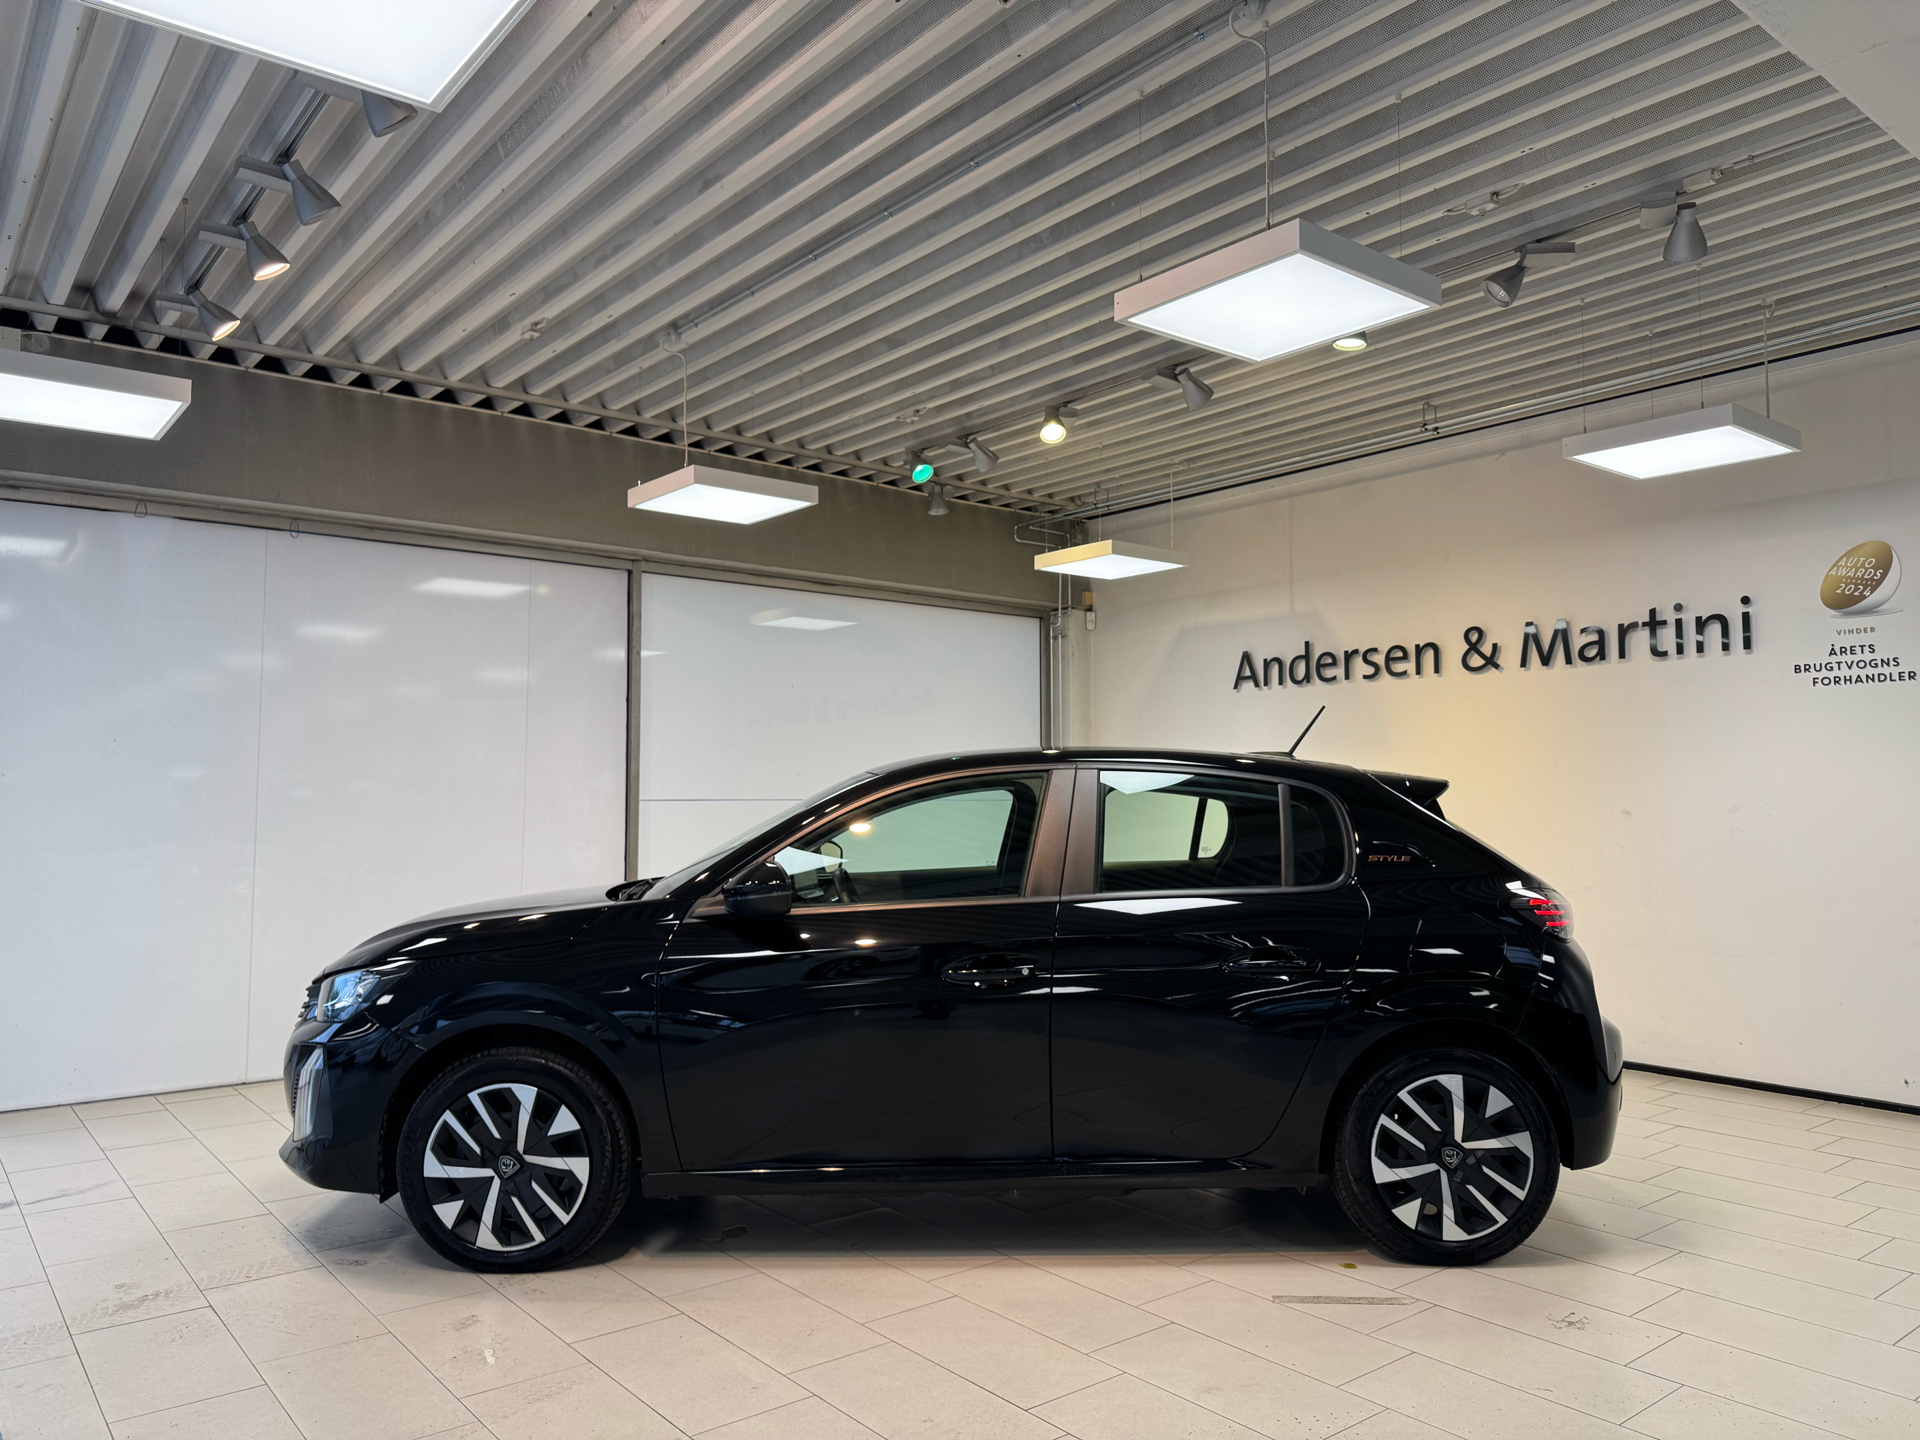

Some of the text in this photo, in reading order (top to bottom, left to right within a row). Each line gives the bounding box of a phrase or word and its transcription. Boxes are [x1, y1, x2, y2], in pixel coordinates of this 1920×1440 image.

[1837, 557, 1876, 568] AUTO
[1828, 567, 1884, 580] AWARDS
[1836, 584, 1872, 597] 2024
[1836, 627, 1875, 636] VINDER
[1232, 595, 1752, 691] Andersen & Martini
[1828, 643, 1876, 657] ÅRETS
[1794, 656, 1900, 674] BRUGTVOGNS
[1812, 671, 1917, 687] FORHANDLER
